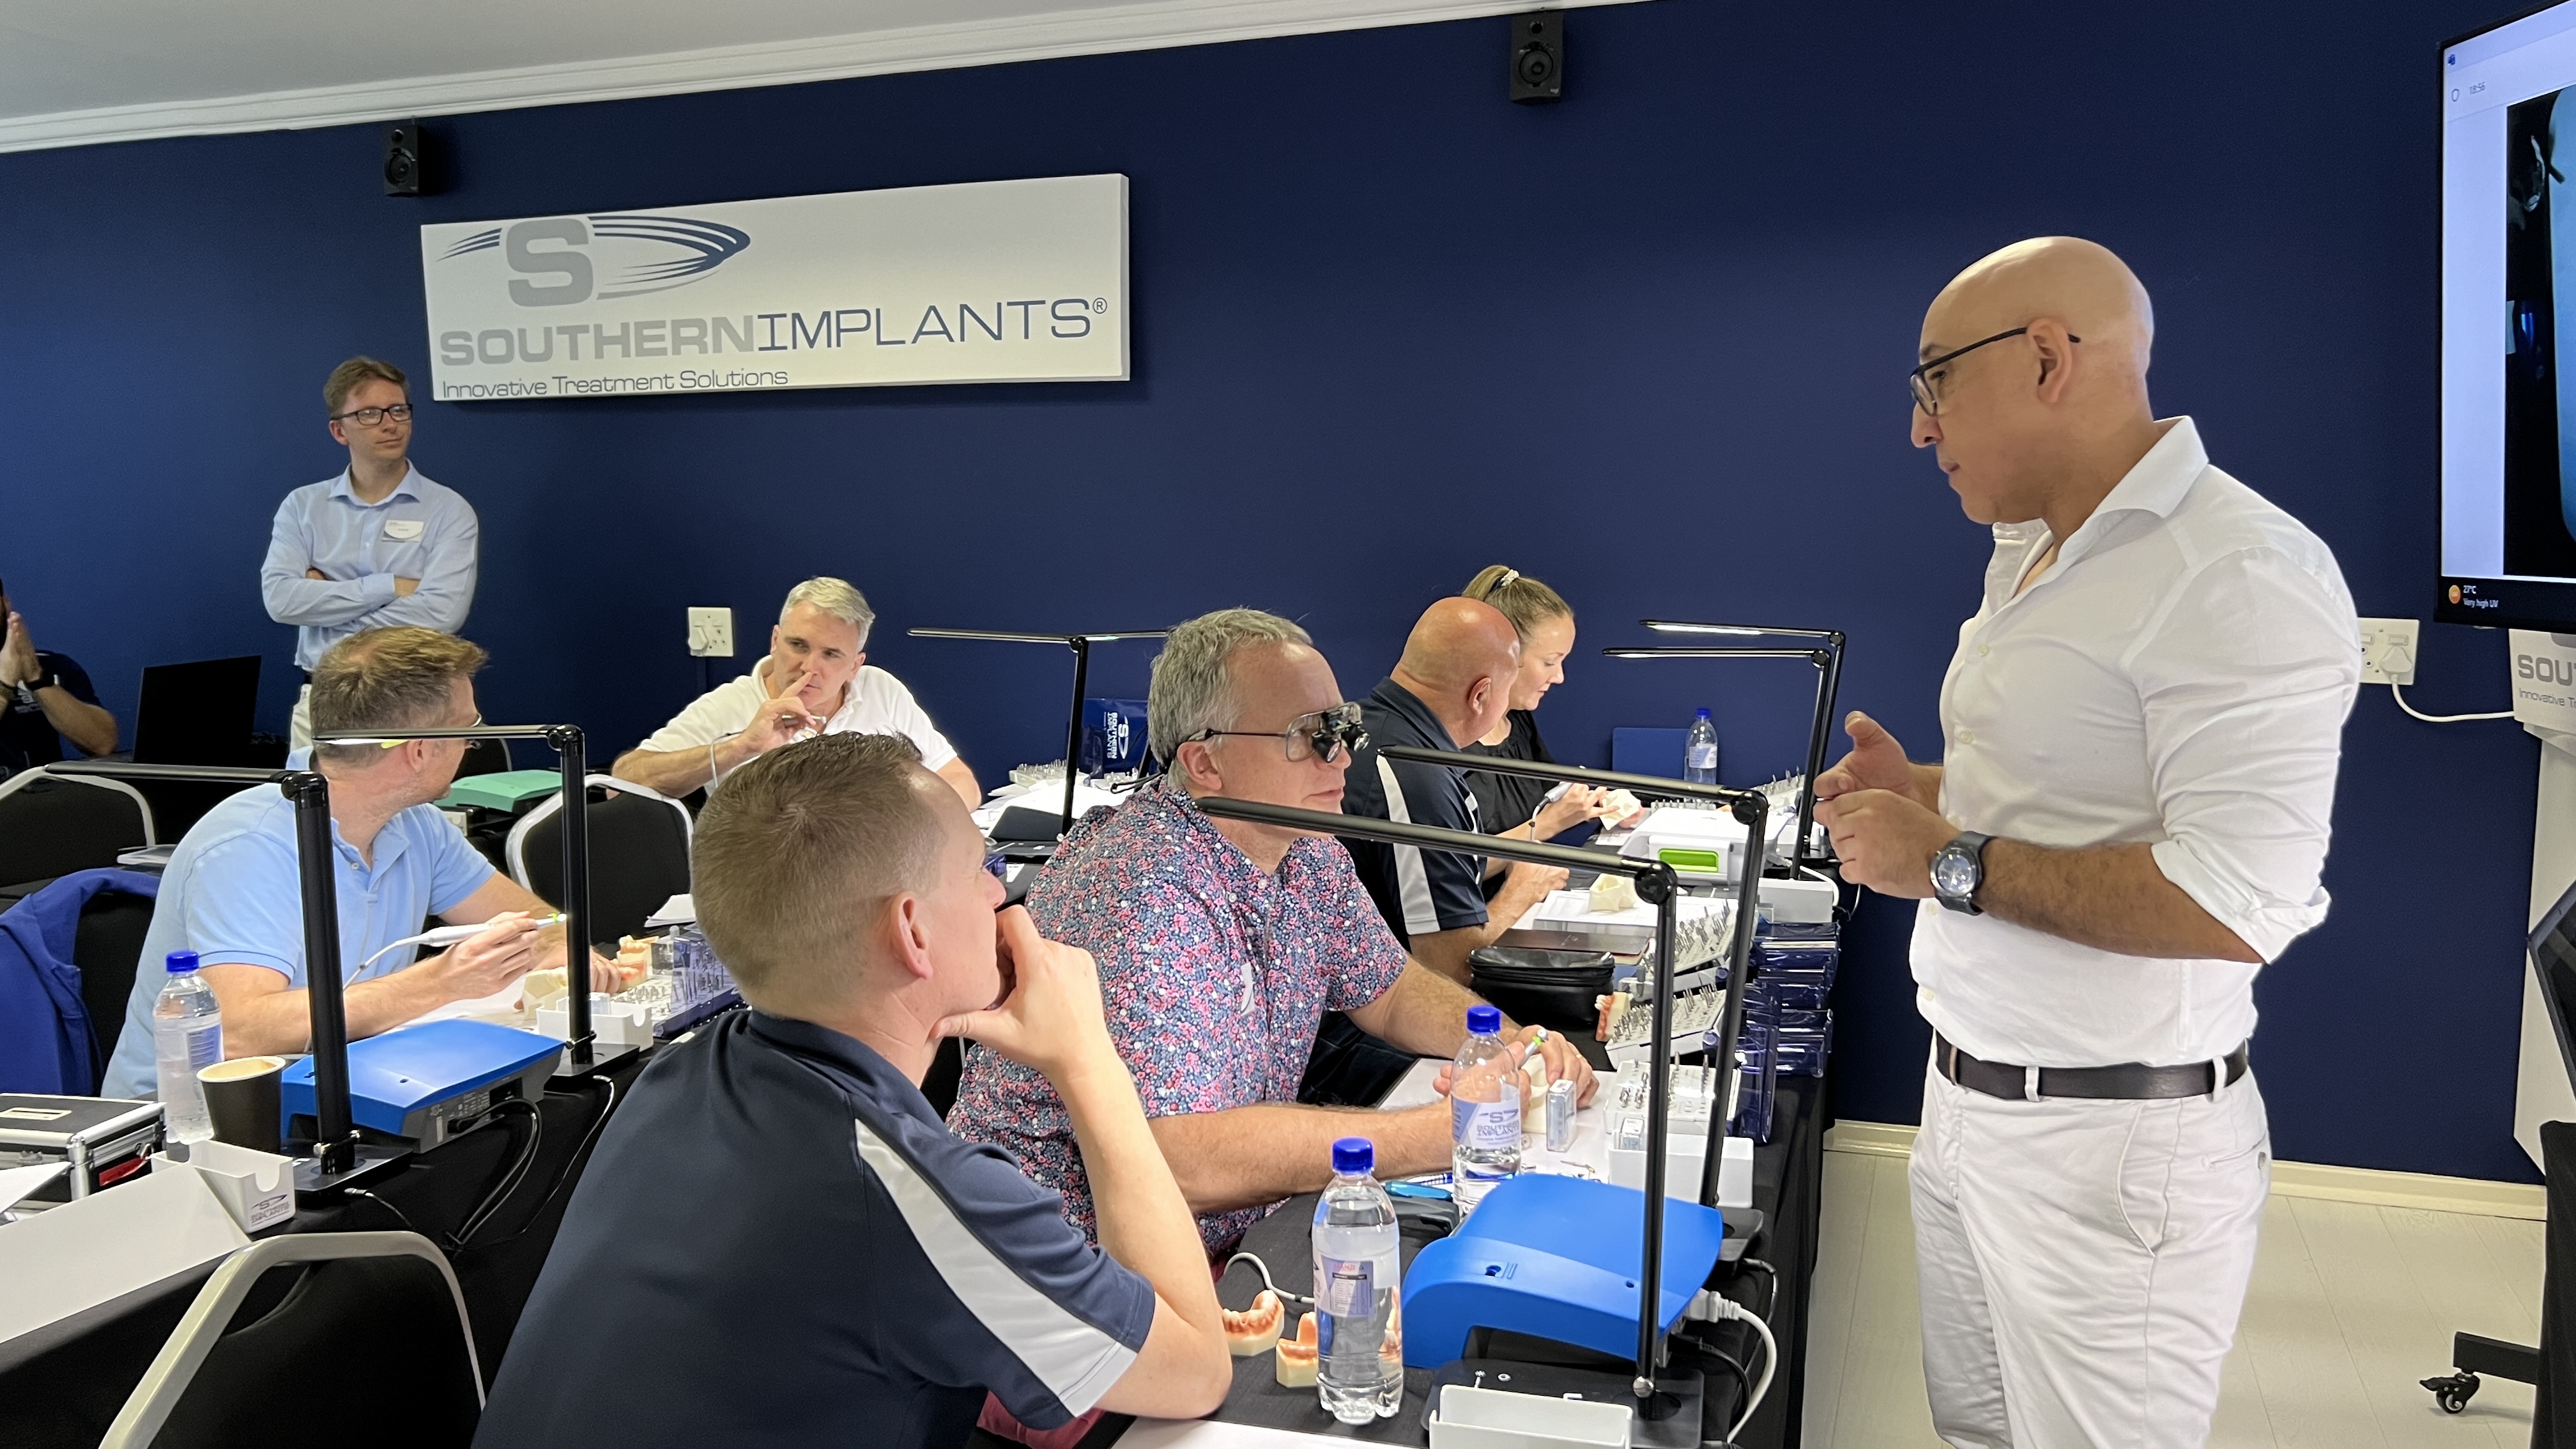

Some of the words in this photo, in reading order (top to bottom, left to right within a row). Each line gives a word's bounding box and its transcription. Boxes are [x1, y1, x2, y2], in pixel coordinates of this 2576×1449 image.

[506, 218, 594, 307] S
[443, 378, 548, 399] Innovative
[552, 372, 675, 395] Treatment
[679, 368, 788, 388] Solutions
[2517, 654, 2576, 686] SOU
[2518, 687, 2566, 707] Innovative
